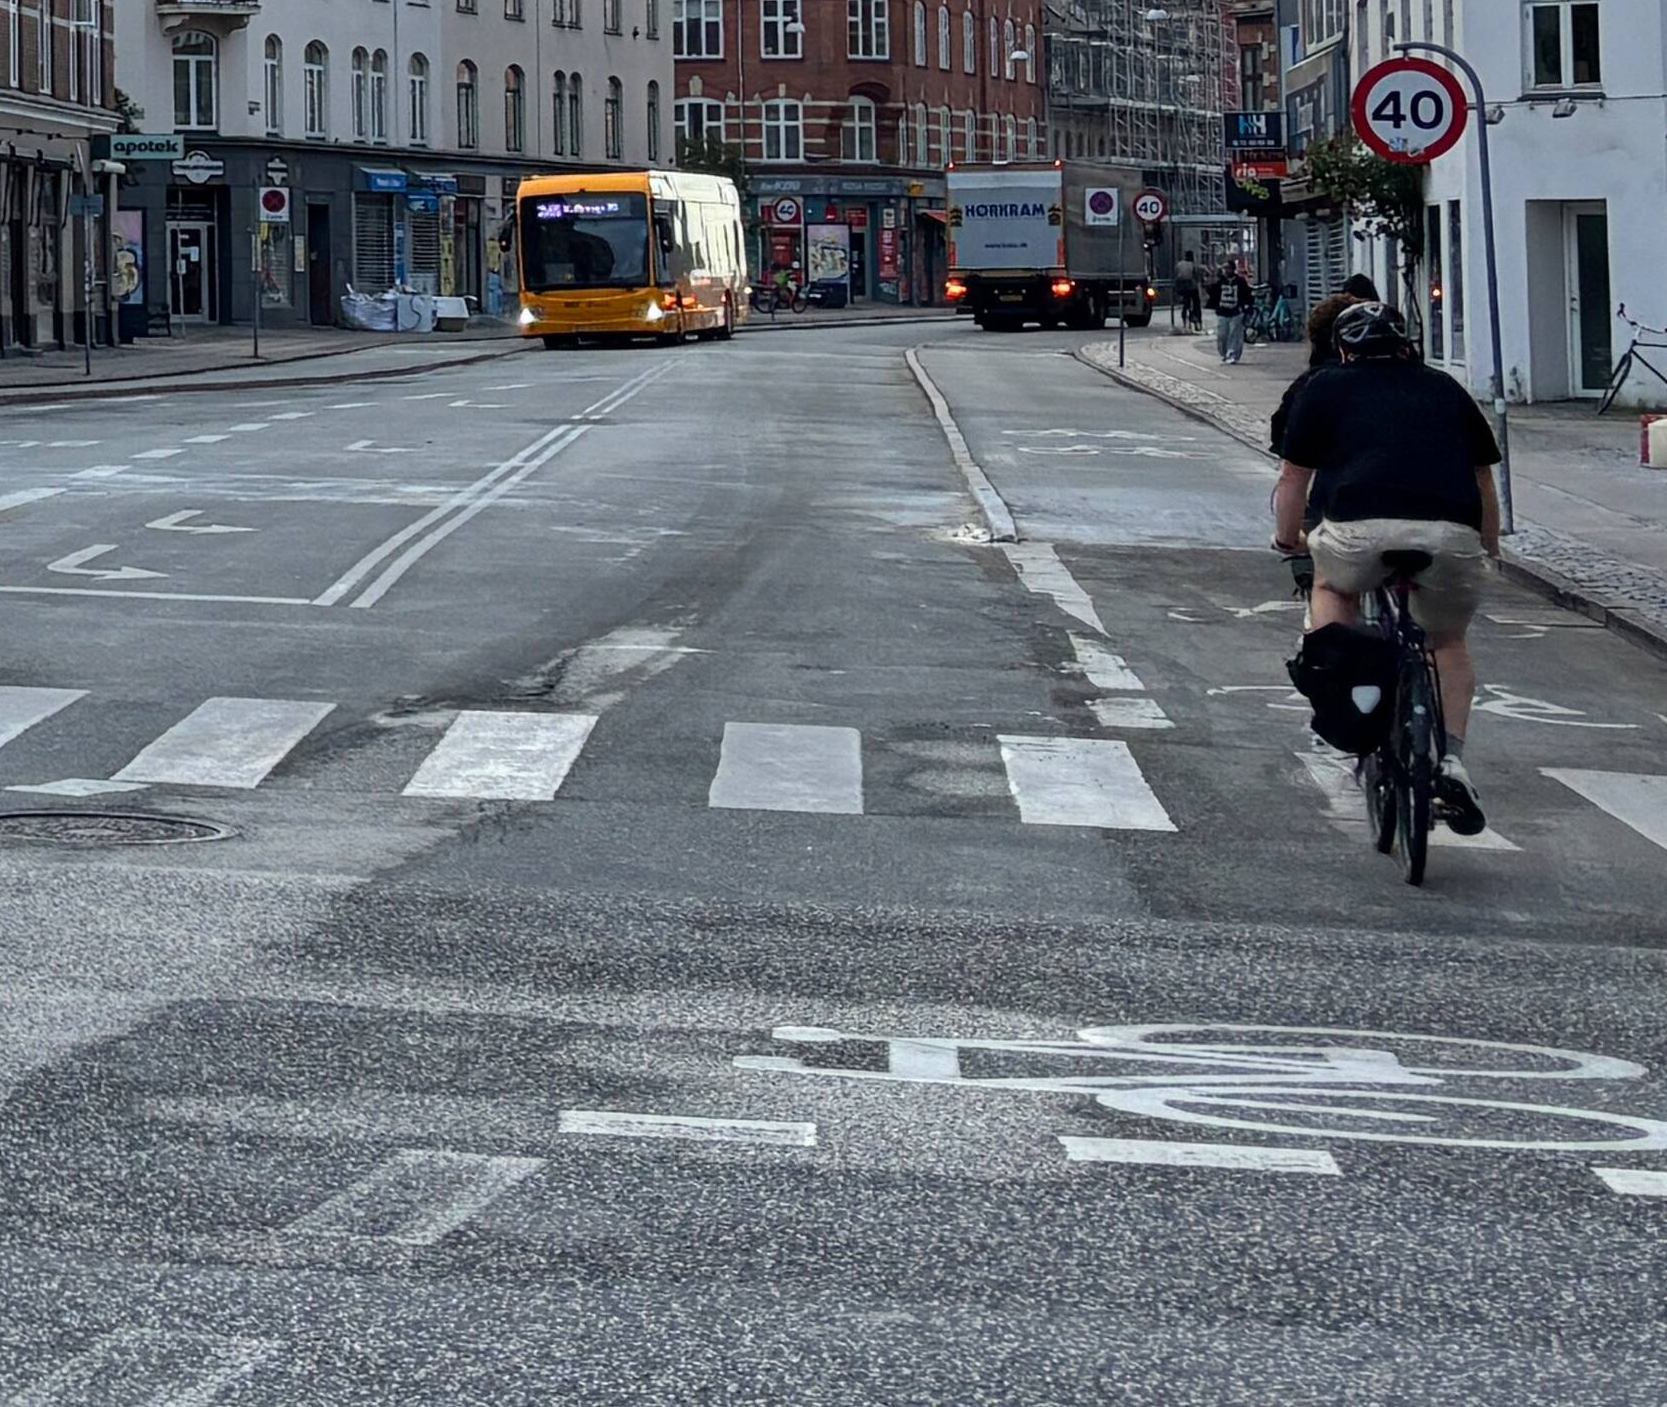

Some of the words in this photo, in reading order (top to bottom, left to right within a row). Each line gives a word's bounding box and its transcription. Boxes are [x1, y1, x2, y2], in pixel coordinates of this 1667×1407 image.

[1372, 90, 1444, 129] 40
[114, 140, 178, 156] apotek
[1138, 201, 1160, 214] 40
